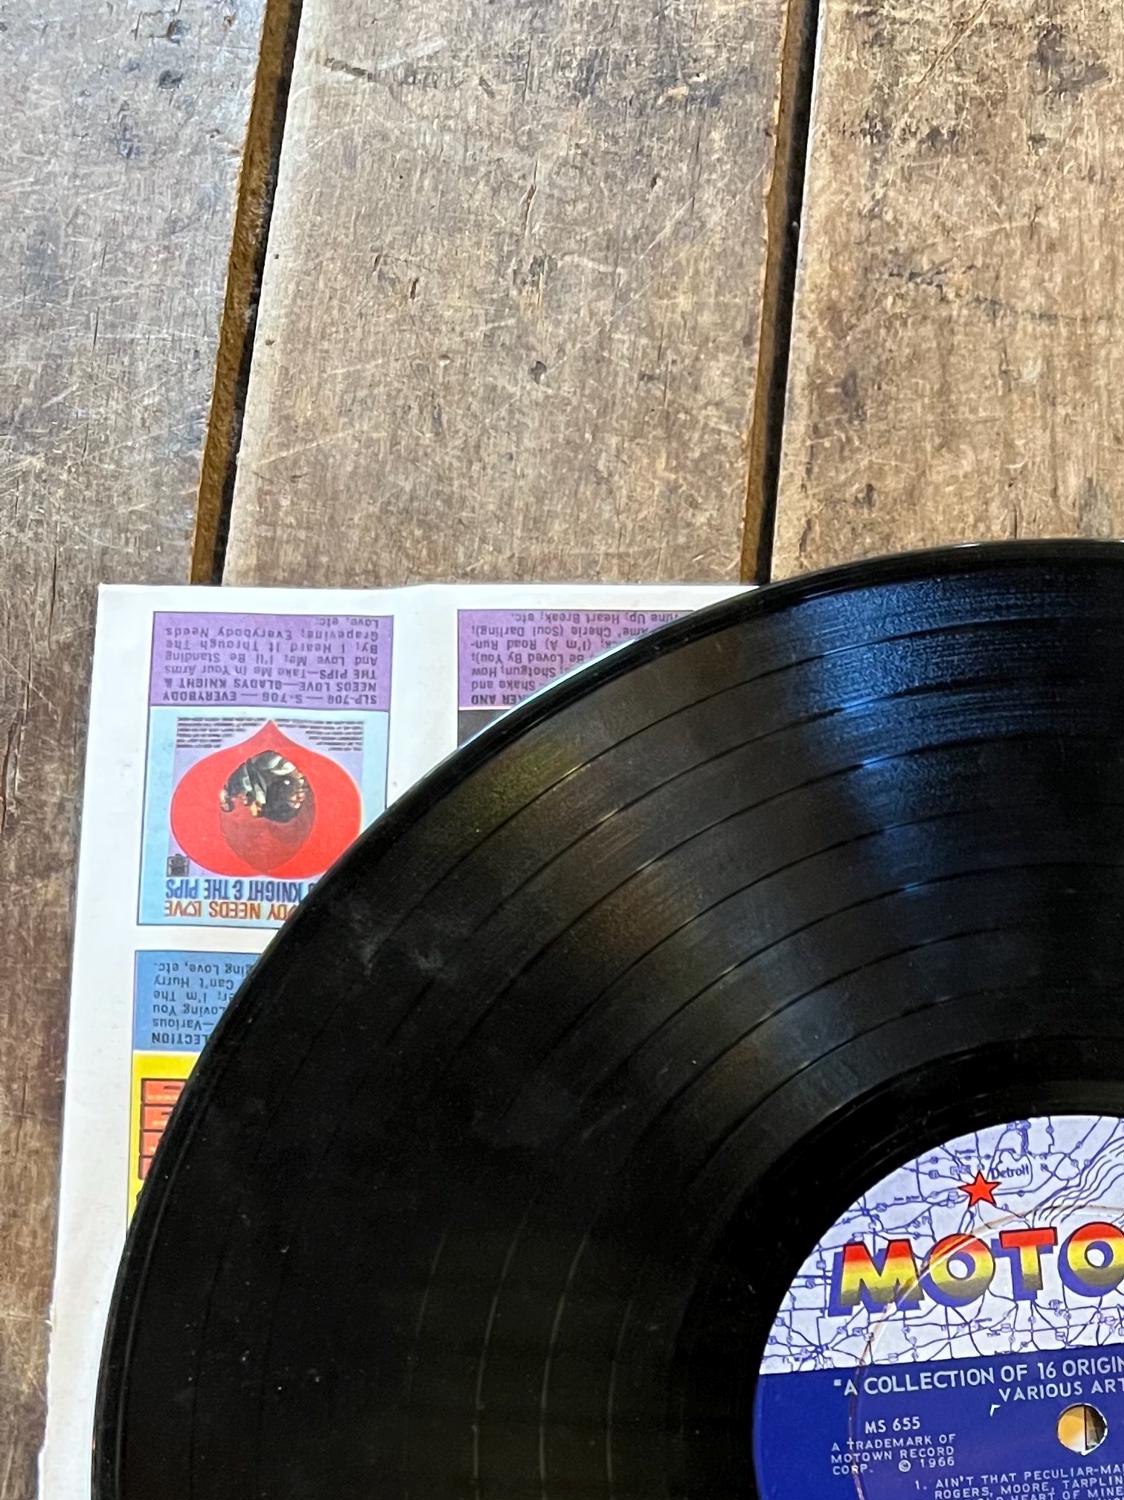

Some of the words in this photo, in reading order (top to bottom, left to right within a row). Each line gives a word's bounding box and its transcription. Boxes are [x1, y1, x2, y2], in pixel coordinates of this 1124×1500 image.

[585, 613, 620, 623] Heart
[506, 640, 537, 650] Road
[317, 656, 345, 665] Love
[354, 656, 378, 666] And
[508, 652, 522, 664] By
[526, 653, 564, 663] Loved
[353, 669, 377, 679] THE
[471, 667, 497, 678] How
[178, 678, 227, 688] KNIGHT
[336, 681, 377, 692] NEEDS
[471, 680, 493, 691] and
[499, 680, 536, 691] Shake
[471, 694, 496, 705] AND
[165, 879, 198, 899] PIPS
[204, 880, 230, 900] THE
[232, 880, 243, 900] &
[246, 880, 303, 903] KNIGHT
[208, 901, 260, 919] NEEDS
[154, 963, 179, 973] etc.
[153, 975, 189, 988] Hurry
[199, 978, 234, 990] Can't
[153, 991, 175, 1001] The
[153, 1005, 177, 1016] You
[990, 1164, 1030, 1181] Detroit
[864, 1366, 994, 1395] COLLECTION
[1001, 1364, 1028, 1383] OF
[1037, 1361, 1057, 1380] 16
[999, 1381, 1082, 1403] VARIOUS
[865, 1419, 886, 1434] MS
[892, 1416, 920, 1431] 655
[831, 1442, 840, 1452] A
[847, 1434, 932, 1451] TRADEMARK
[939, 1433, 955, 1444] OF
[831, 1450, 892, 1465] MOTOWN
[900, 1445, 954, 1459] RECORD
[832, 1463, 874, 1476] CORP.
[920, 1456, 955, 1469] 1966
[935, 1475, 974, 1489] AIN'T
[981, 1472, 1017, 1485] THAT
[1000, 1481, 1055, 1496] MOORE,
[1062, 1489, 1082, 1500] OF
[1087, 1486, 1124, 1498] MINE
